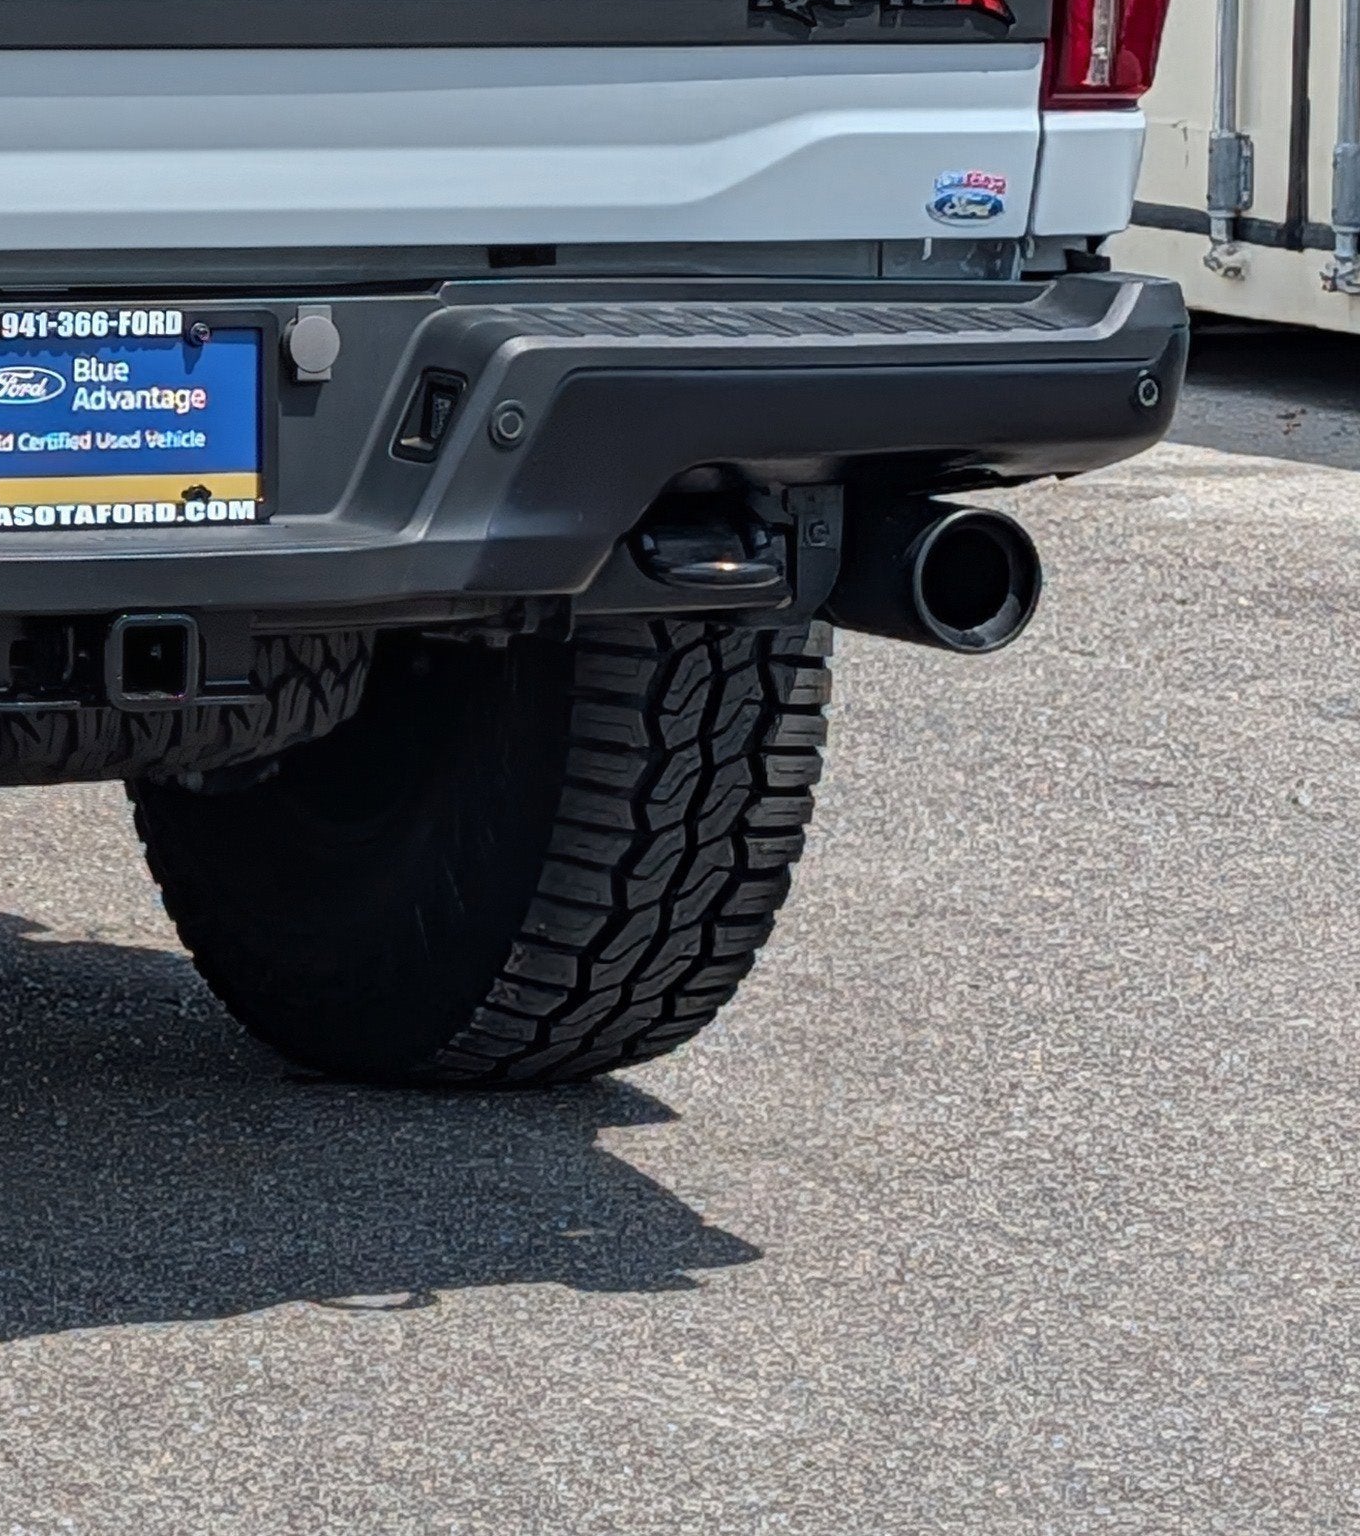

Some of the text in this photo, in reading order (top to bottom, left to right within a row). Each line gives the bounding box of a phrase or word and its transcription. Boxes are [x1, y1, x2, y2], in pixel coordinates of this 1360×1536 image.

[1, 310, 183, 339] 941-366-FORD
[73, 357, 130, 383] Blue
[72, 385, 207, 415] Advantage
[17, 430, 92, 452] Certified
[95, 429, 141, 450] Used
[145, 429, 207, 450] Vehicle
